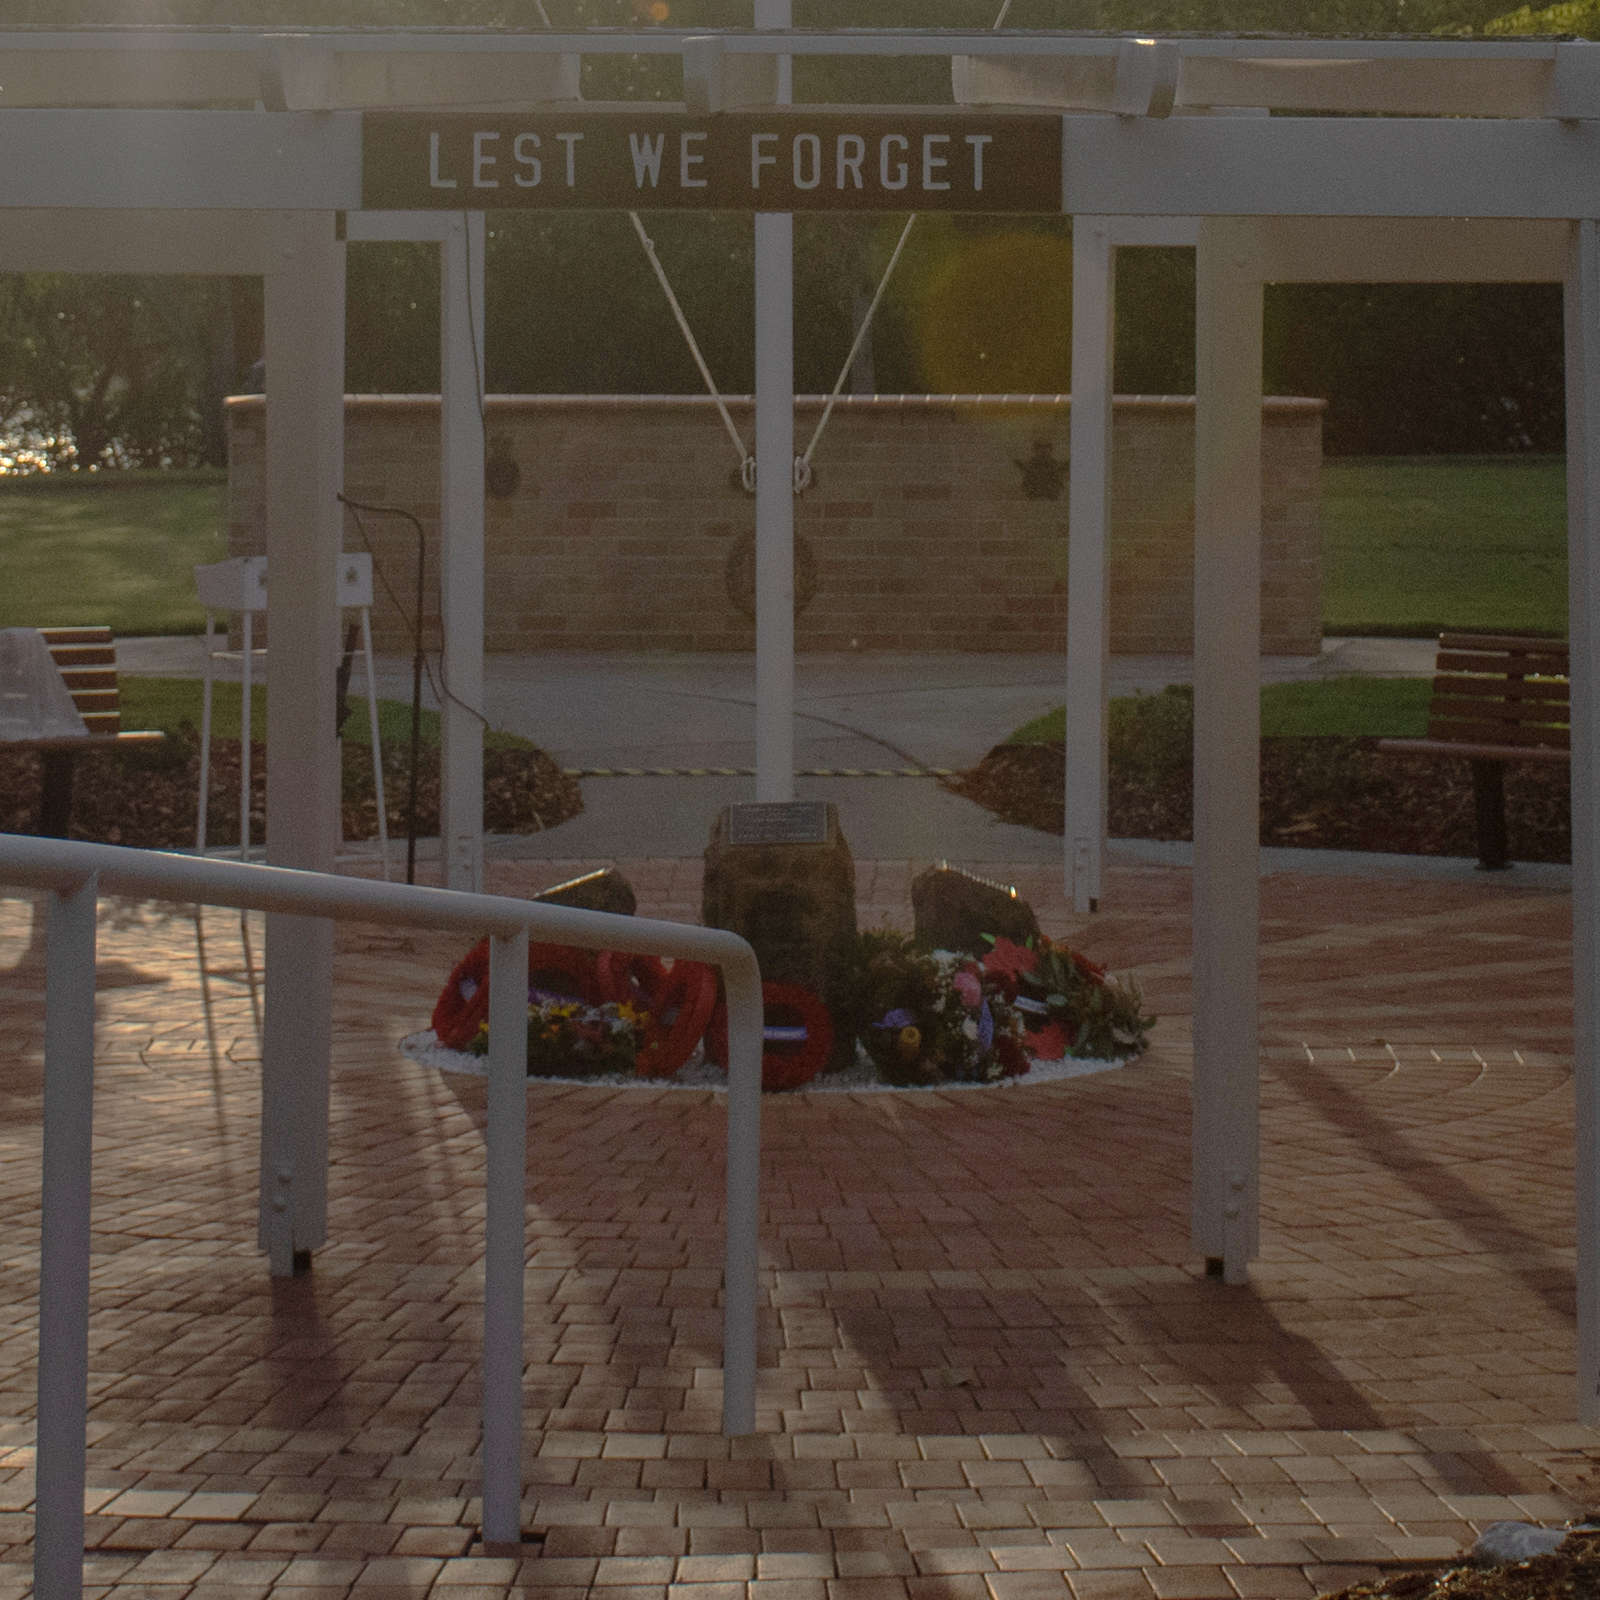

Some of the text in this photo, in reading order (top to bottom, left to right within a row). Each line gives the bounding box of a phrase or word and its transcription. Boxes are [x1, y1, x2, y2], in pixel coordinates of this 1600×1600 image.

[429, 131, 993, 190] LEST WE FORGET
